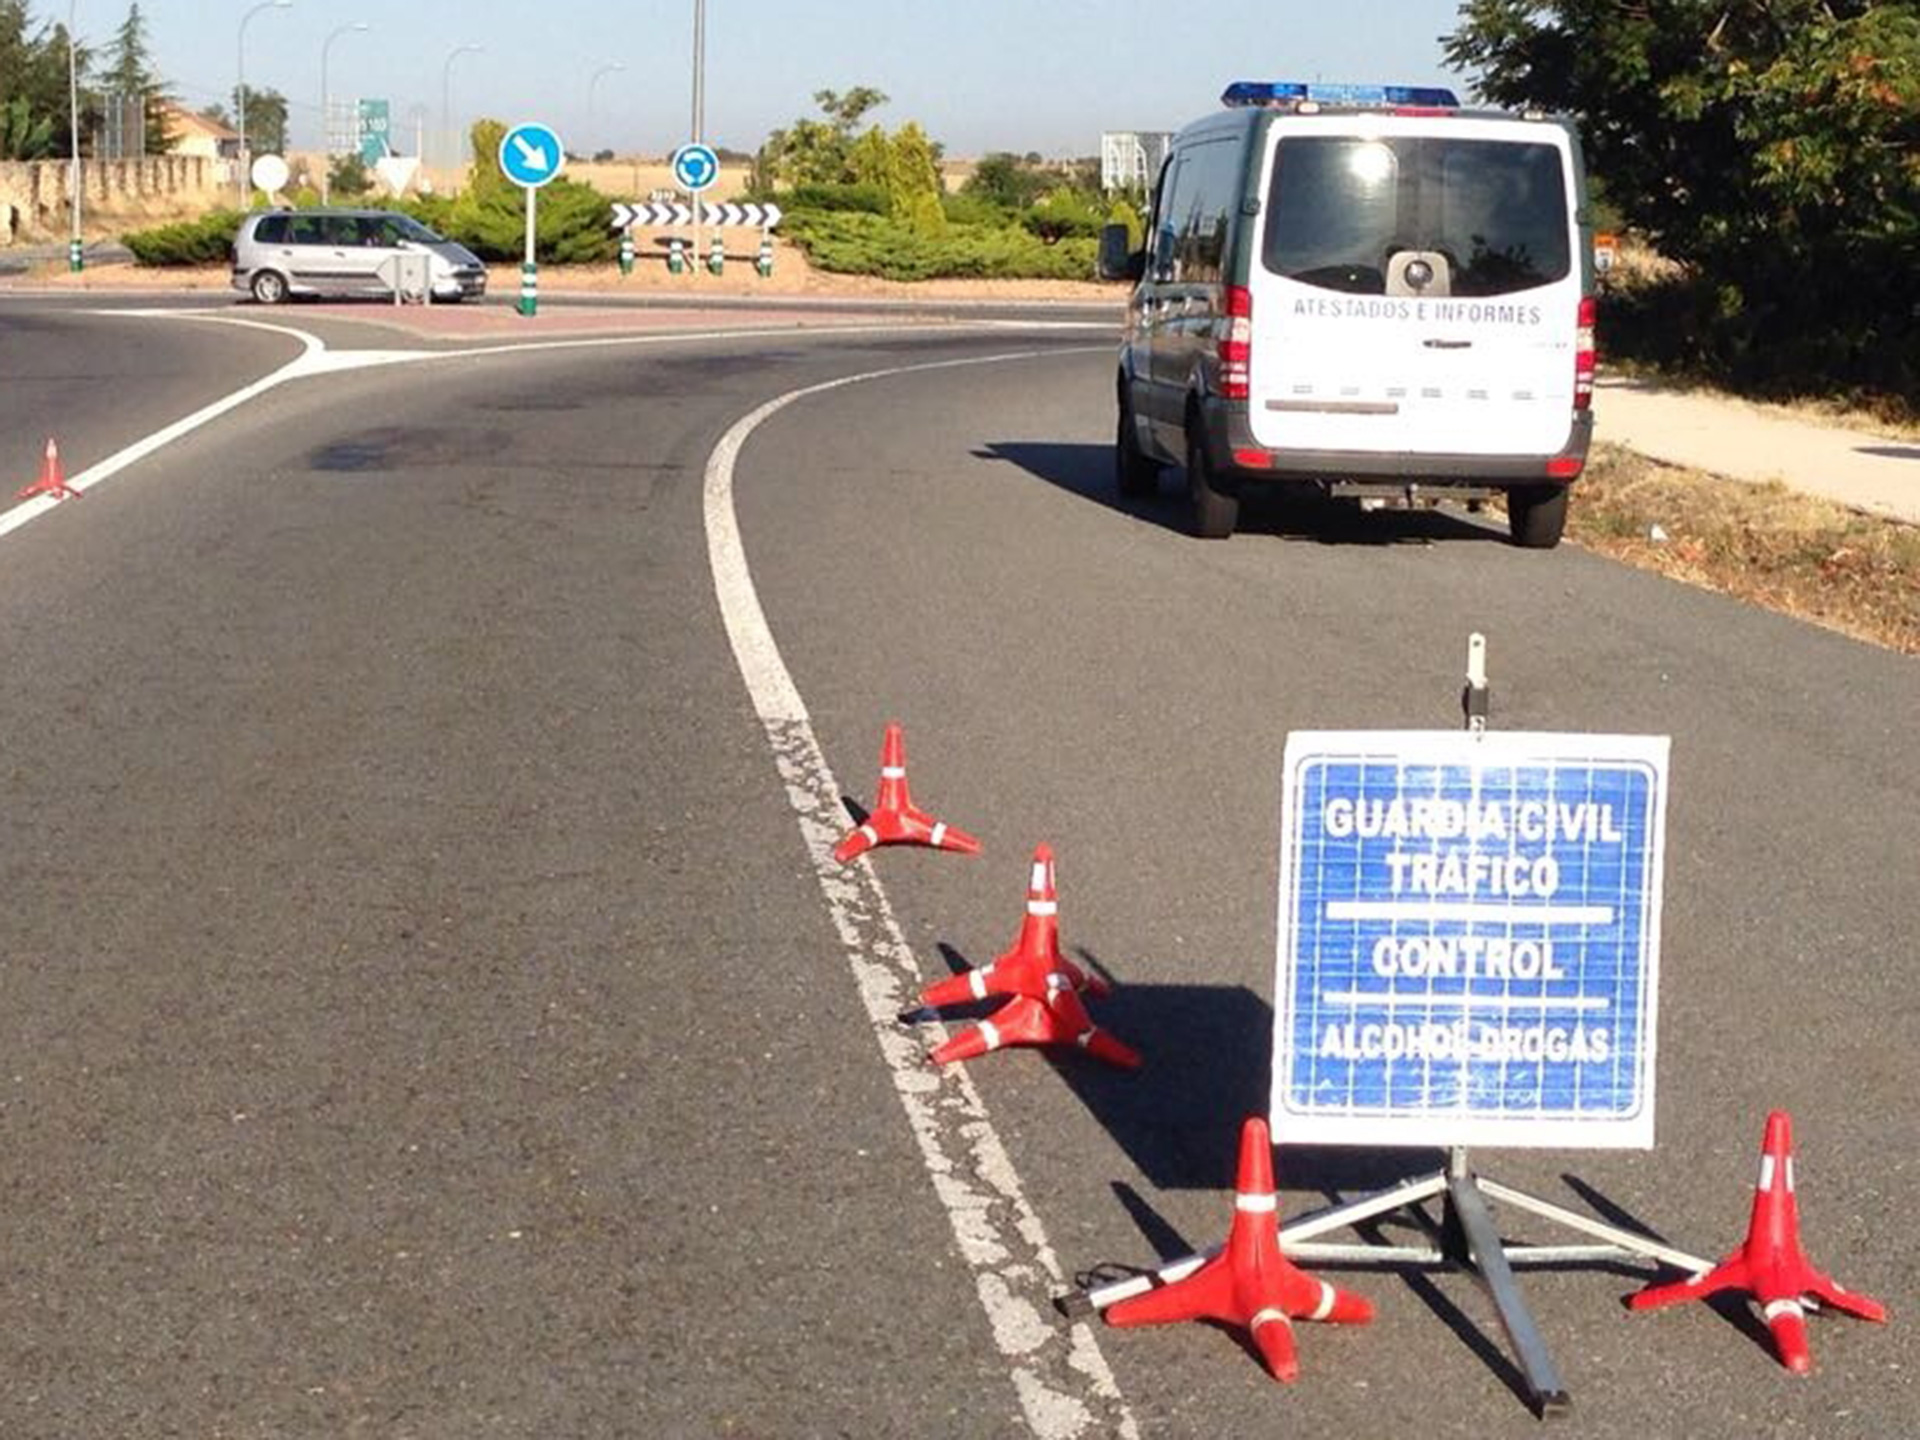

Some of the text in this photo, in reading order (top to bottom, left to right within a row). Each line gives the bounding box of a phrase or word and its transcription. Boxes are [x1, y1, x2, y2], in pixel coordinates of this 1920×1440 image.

[1294, 299, 1541, 325] ATESTADOS E INFORMES
[1325, 797, 1622, 842] GUARDIA CIVIL
[1385, 854, 1560, 897] TRAFICO
[1372, 936, 1566, 980] CONTROL
